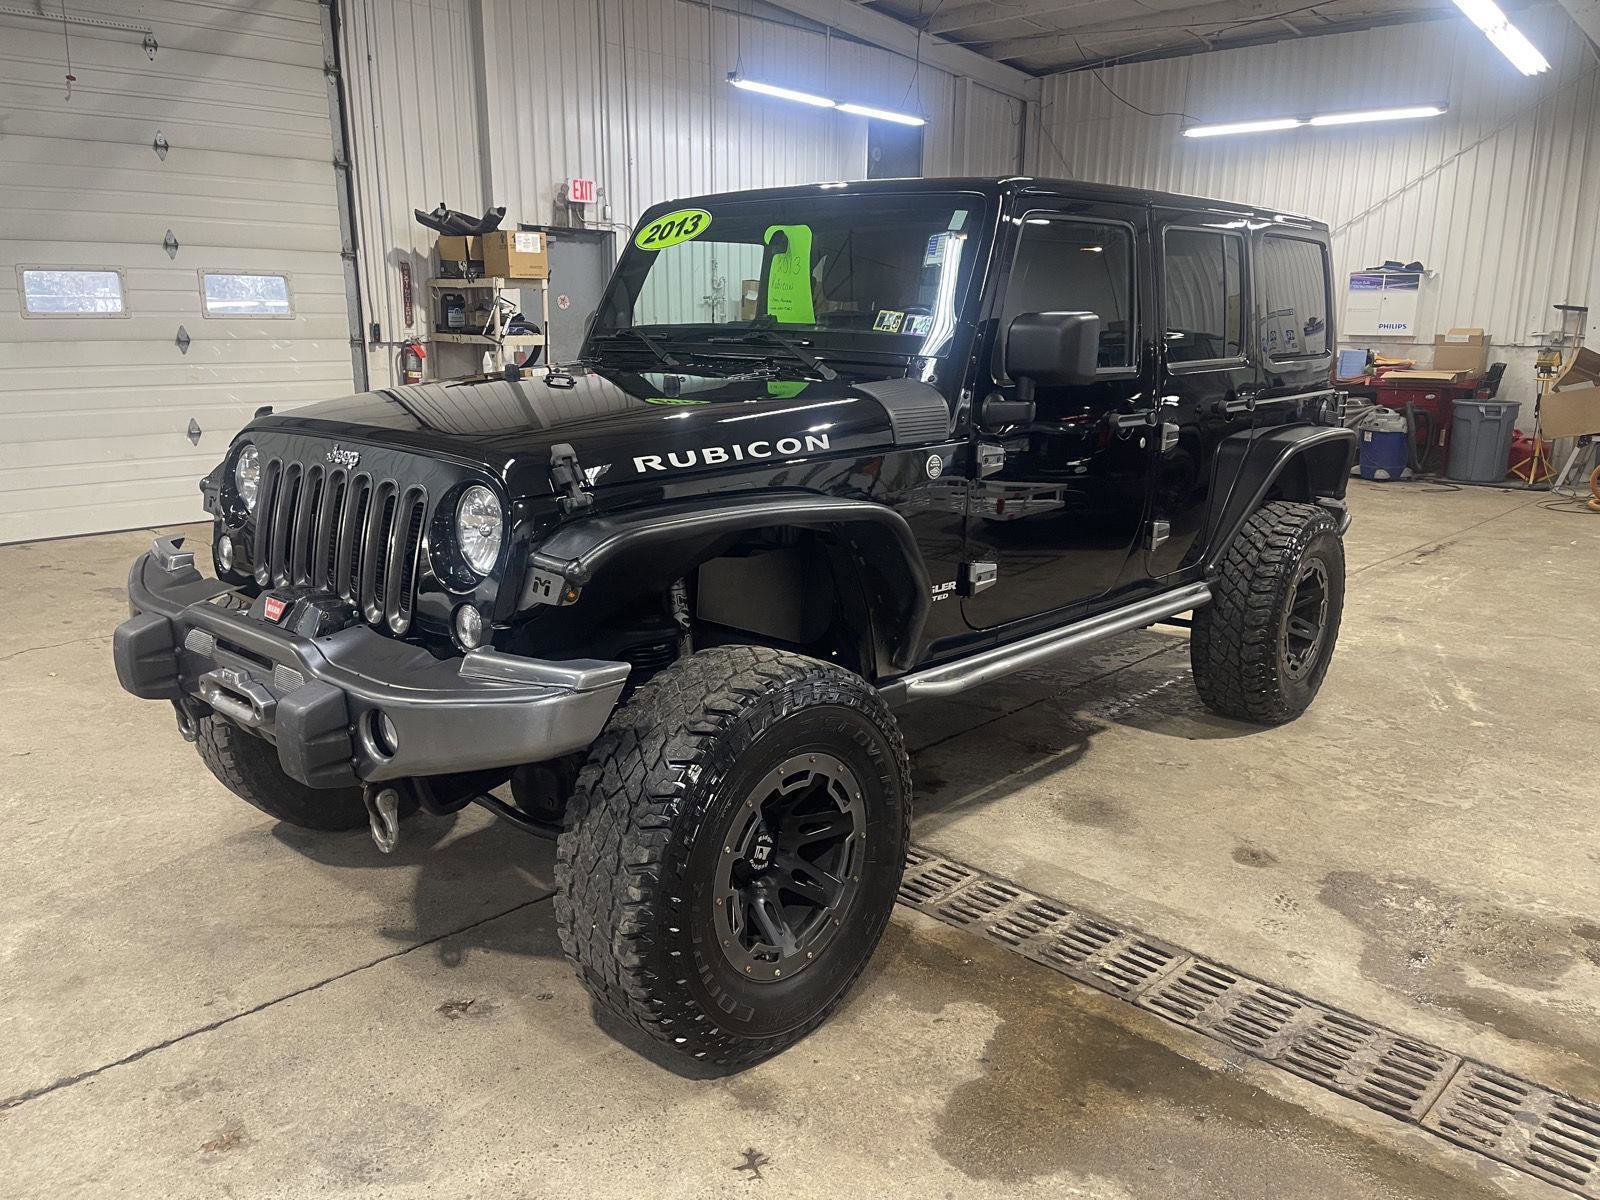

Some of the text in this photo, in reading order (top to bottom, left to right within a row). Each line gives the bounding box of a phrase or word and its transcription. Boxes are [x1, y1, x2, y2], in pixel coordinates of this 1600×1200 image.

[573, 179, 593, 201] EXIT
[642, 214, 703, 245] 2013
[326, 443, 361, 470] Jeep
[633, 433, 830, 473] RUBICON
